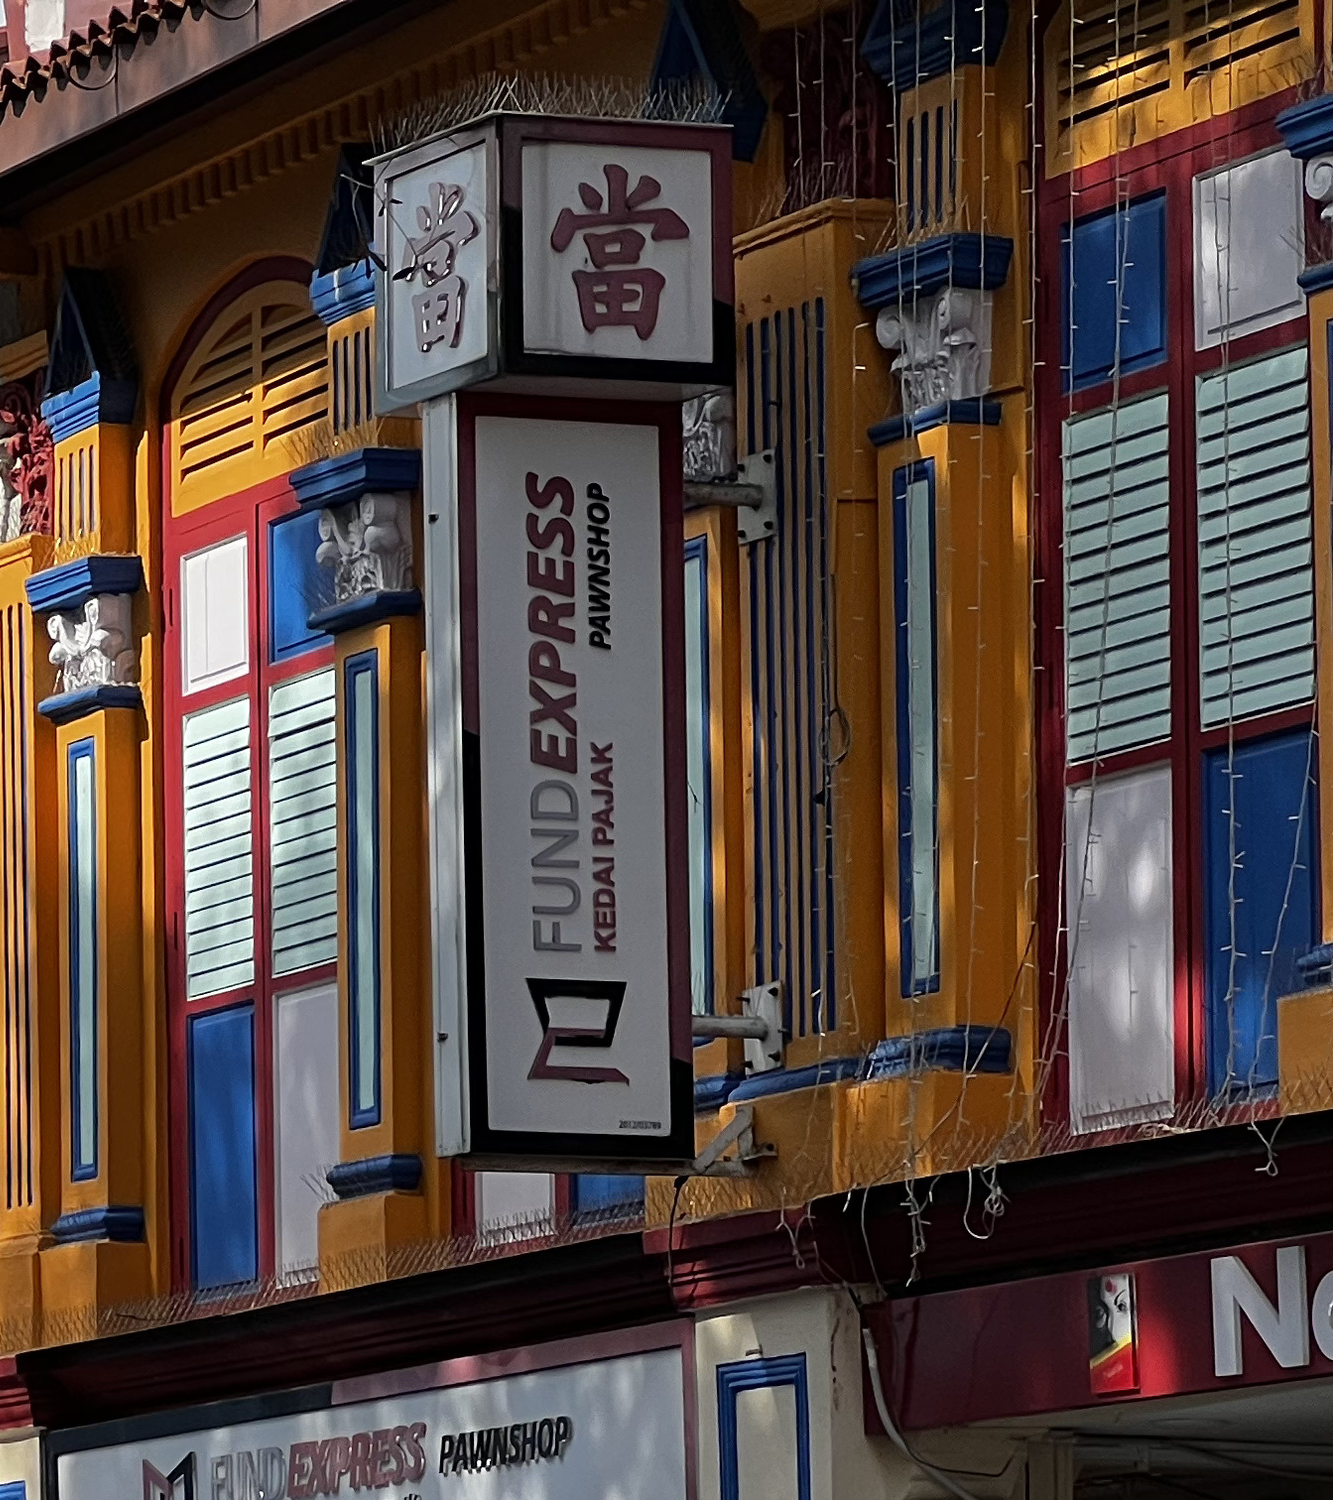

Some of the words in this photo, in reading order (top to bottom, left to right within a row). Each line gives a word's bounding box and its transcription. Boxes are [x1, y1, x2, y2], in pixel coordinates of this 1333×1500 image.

[402, 182, 481, 352] 當
[551, 164, 689, 340] 當
[586, 482, 613, 651] PAWNSHOP
[590, 742, 614, 846] PAJAK
[592, 850, 617, 953] KEDAI
[439, 1416, 572, 1475] PAWNSHOP
